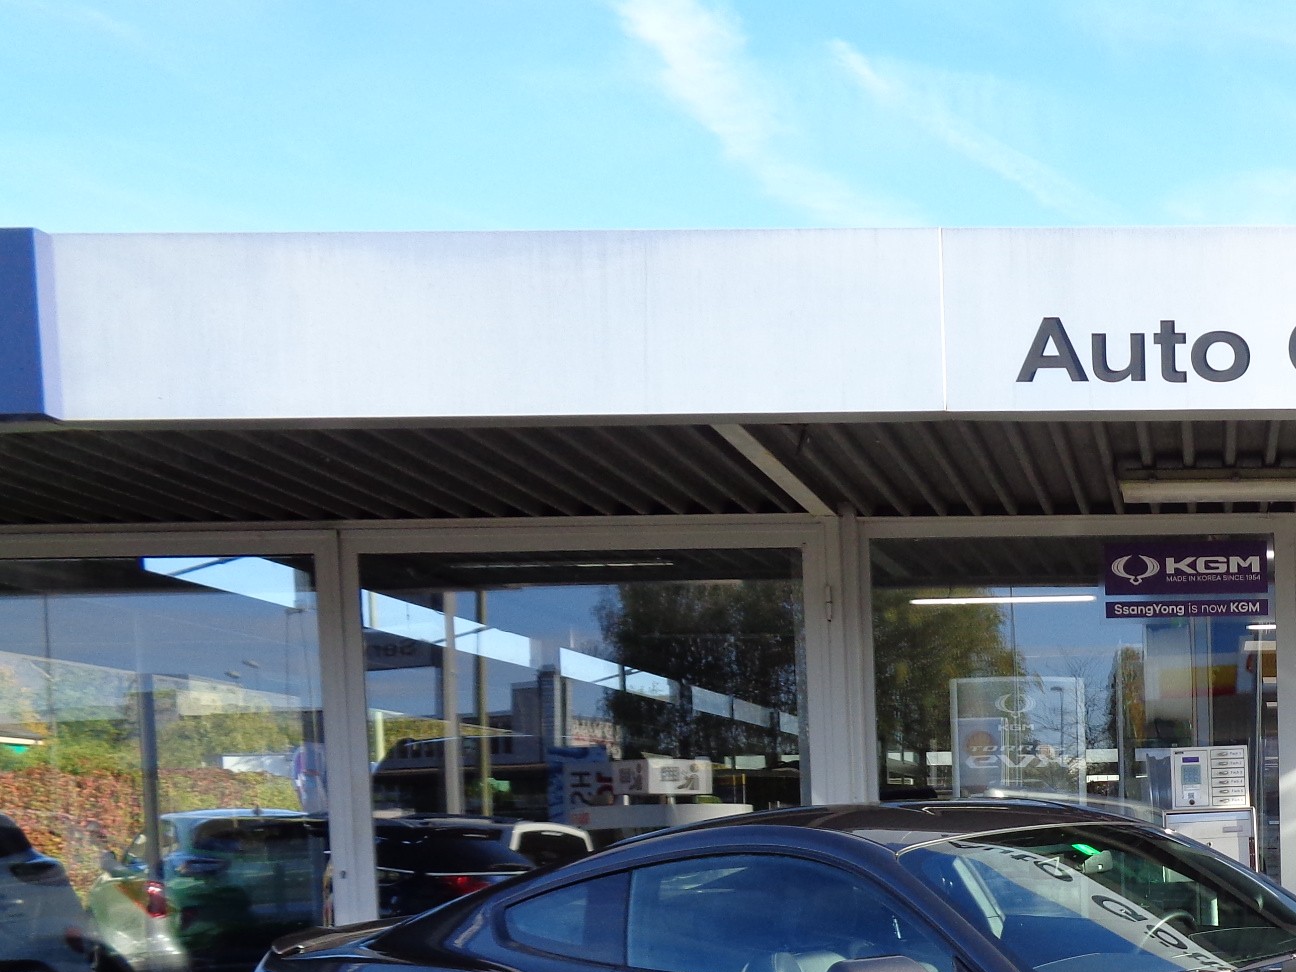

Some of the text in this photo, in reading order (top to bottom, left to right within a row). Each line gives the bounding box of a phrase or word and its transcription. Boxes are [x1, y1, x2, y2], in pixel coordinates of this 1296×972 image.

[1015, 316, 1251, 383] Auto
[1165, 555, 1261, 574] KGM
[1196, 574, 1222, 582] KOREA
[1114, 602, 1260, 616] SsangYong is now KGM
